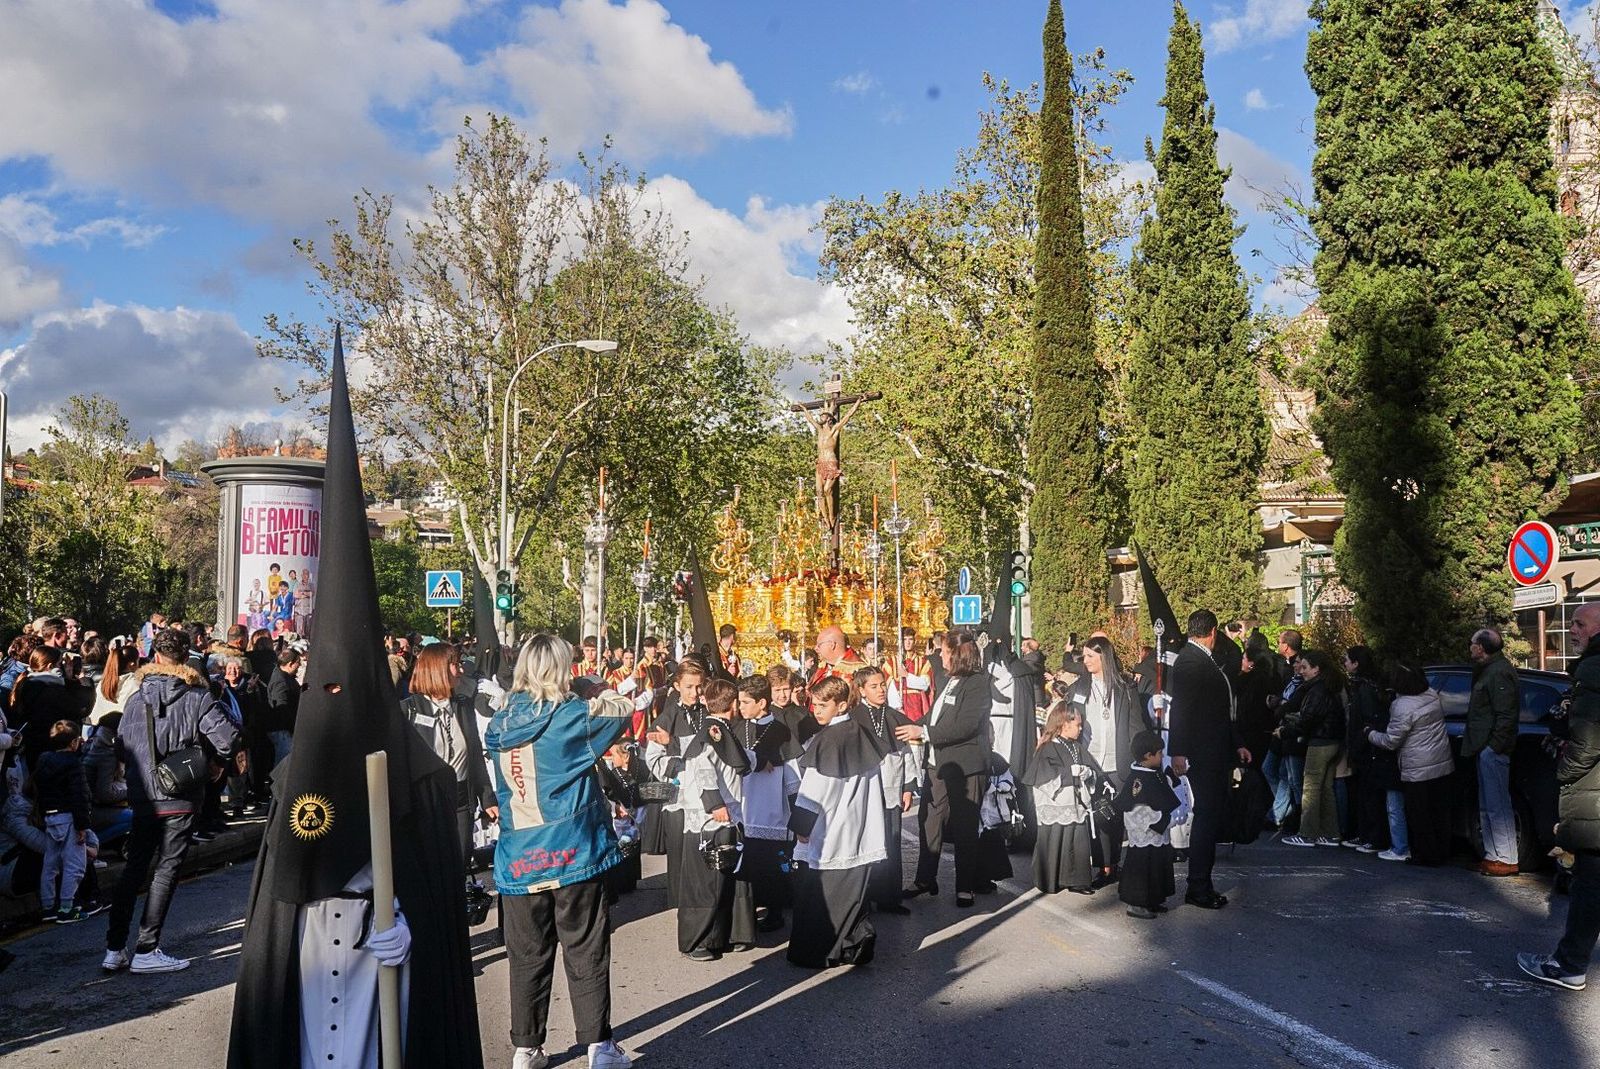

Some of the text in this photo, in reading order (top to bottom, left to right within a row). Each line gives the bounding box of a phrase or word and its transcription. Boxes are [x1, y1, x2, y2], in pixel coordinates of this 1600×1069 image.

[243, 507, 319, 533] LA FAMILIA
[242, 522, 319, 557] BENETON
